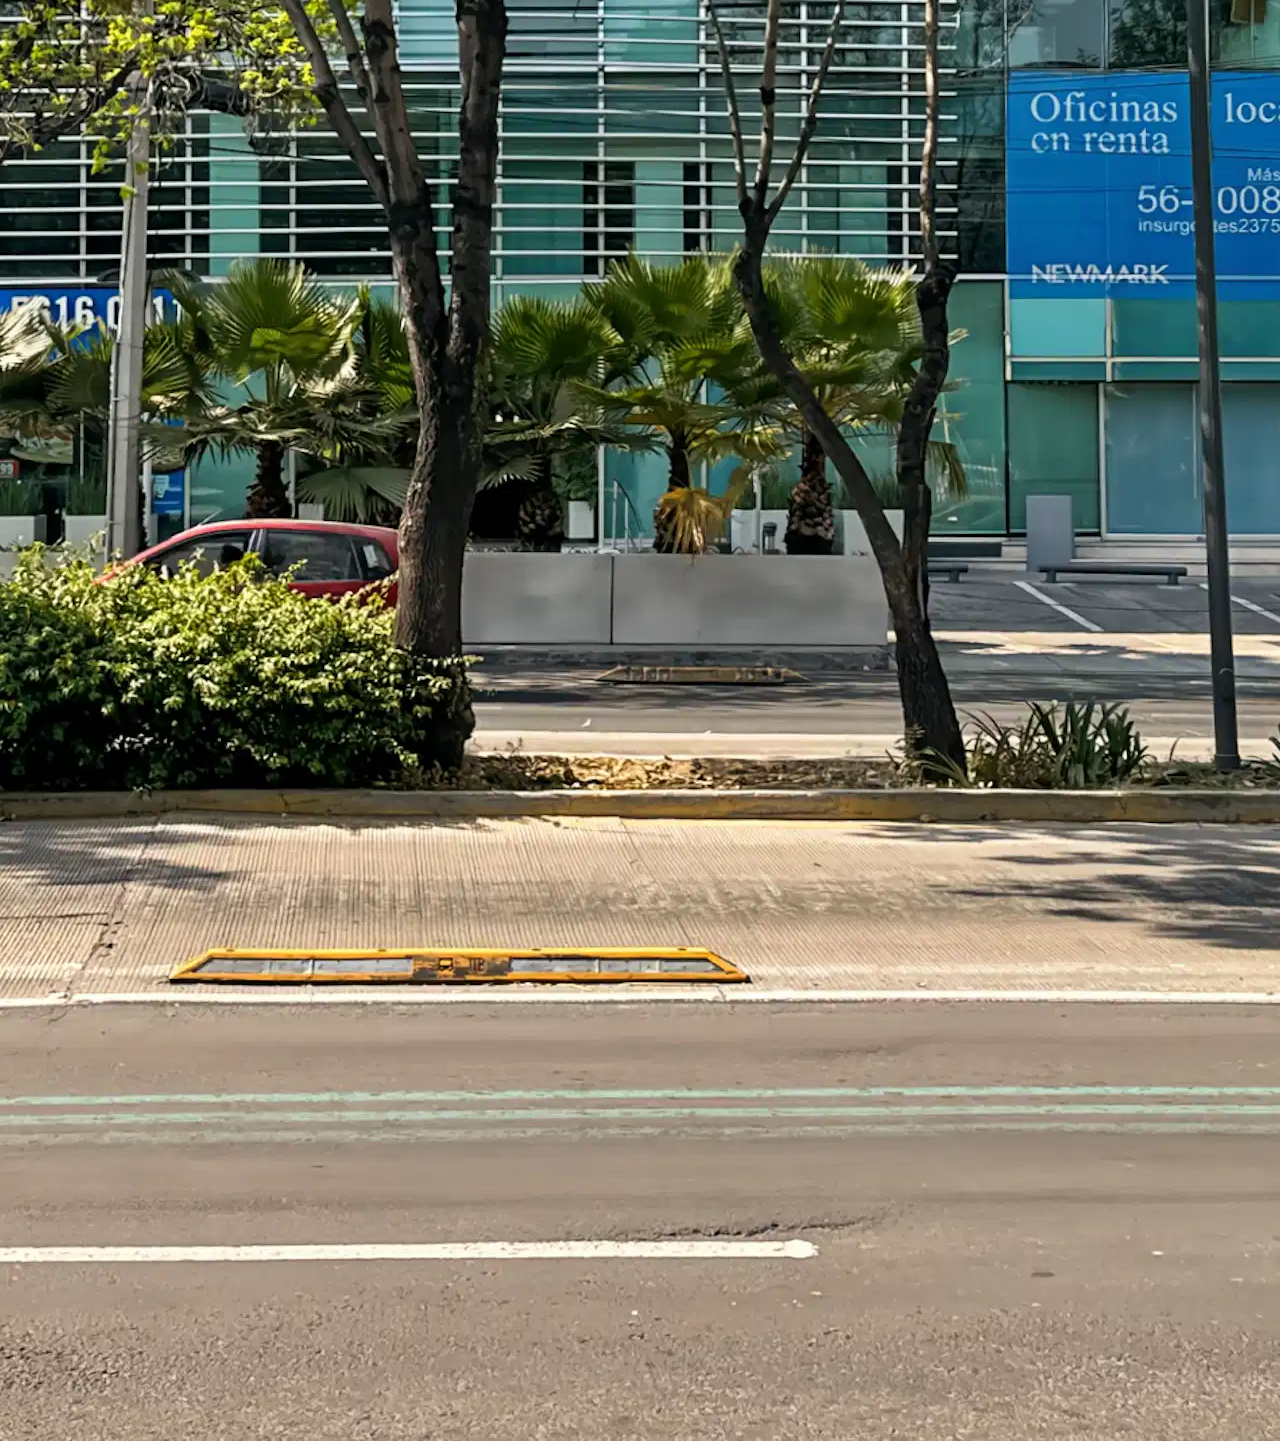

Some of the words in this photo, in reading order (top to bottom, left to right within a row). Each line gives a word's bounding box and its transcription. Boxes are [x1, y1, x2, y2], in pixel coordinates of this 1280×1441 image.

[1030, 91, 1178, 124] Oficinas
[1082, 128, 1171, 154] renta
[1247, 167, 1280, 182] Más
[1031, 263, 1170, 284] NEWMARK
